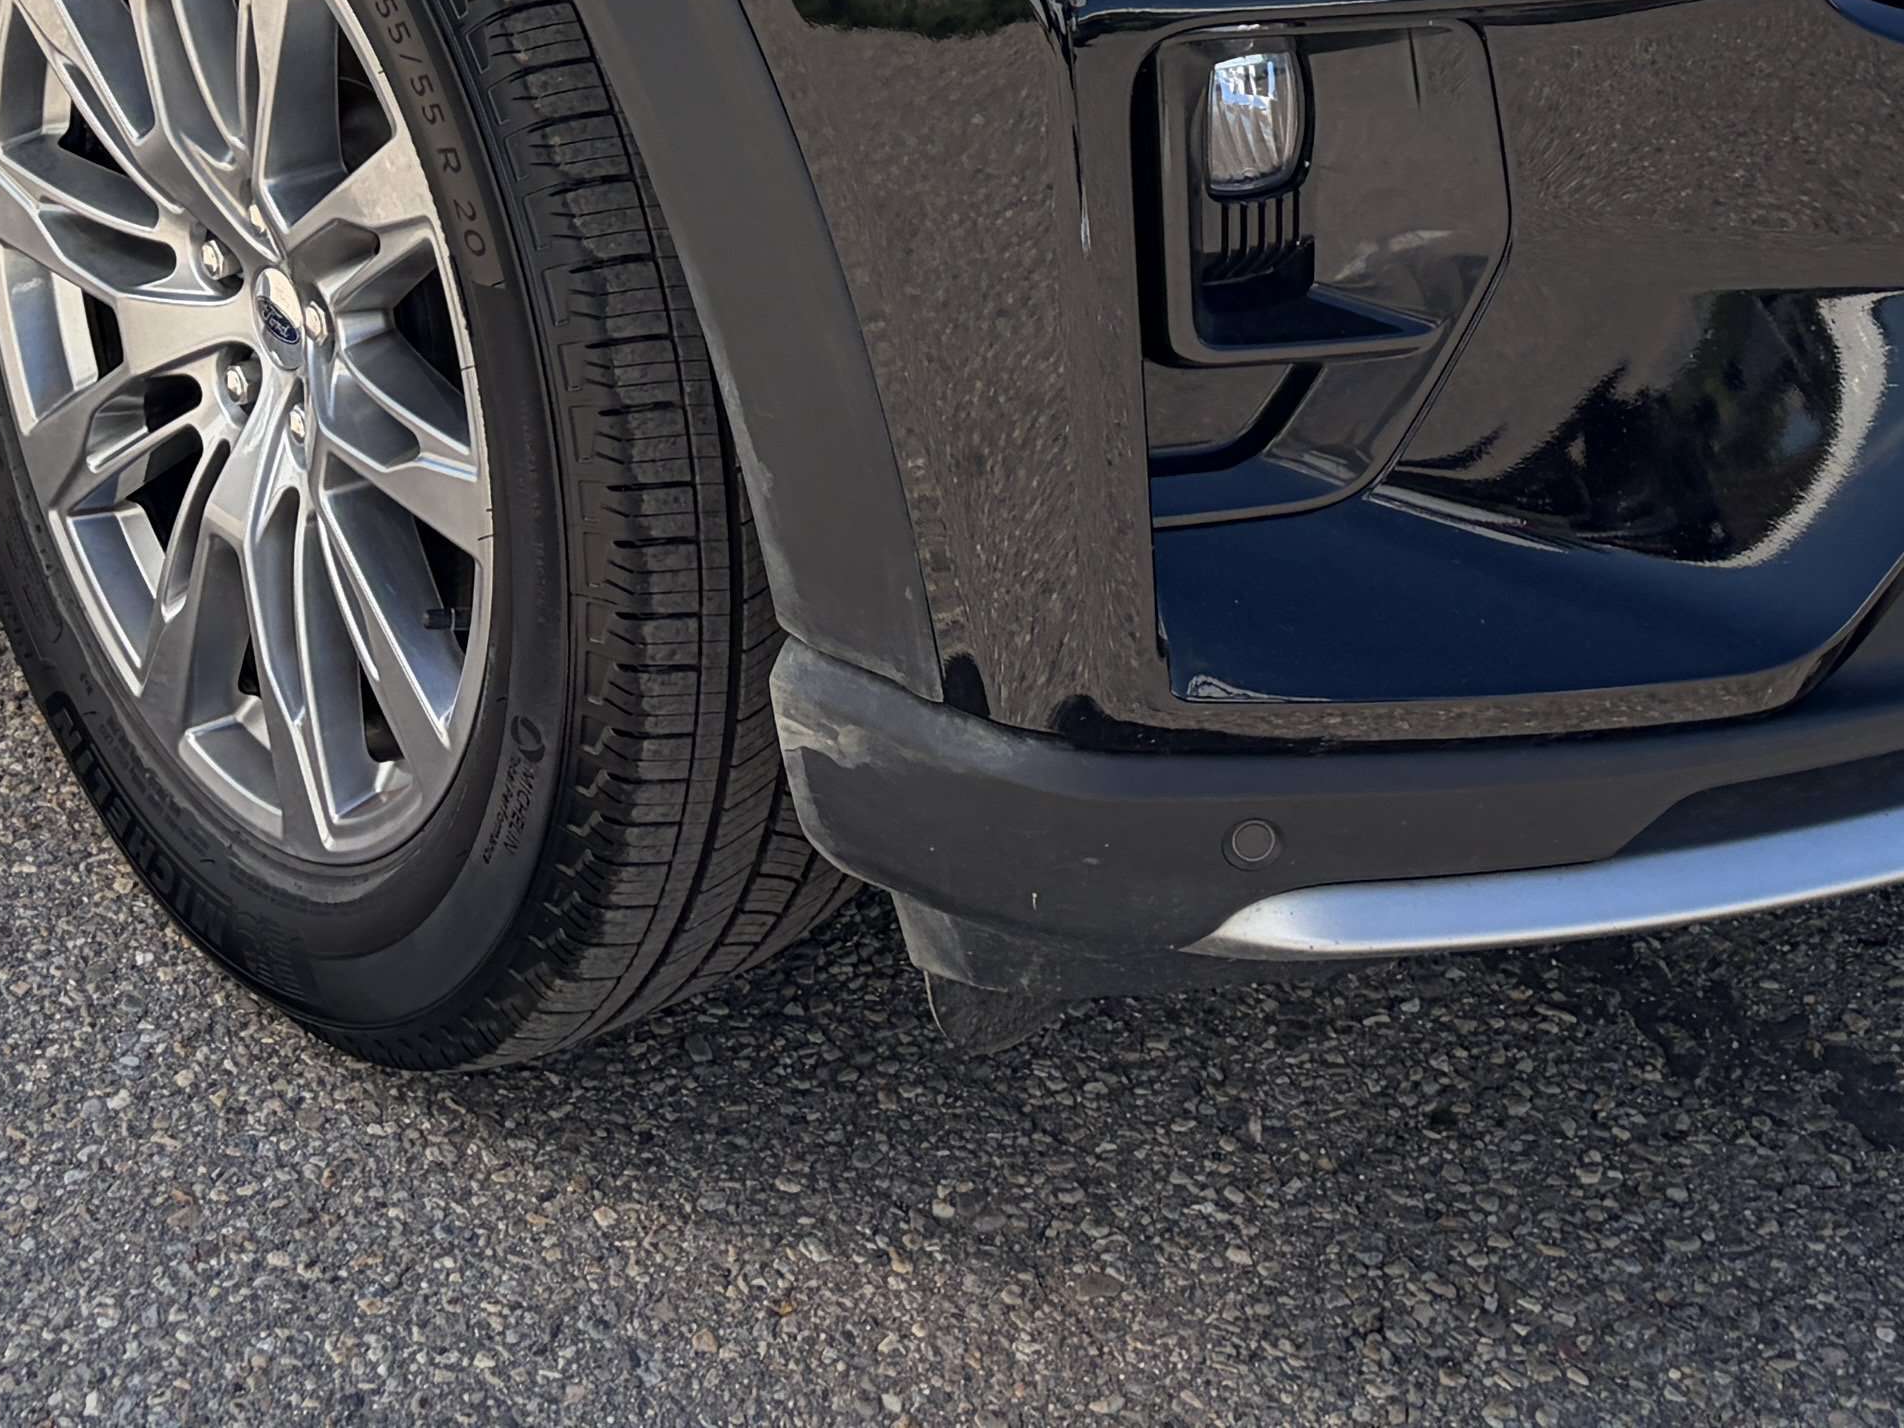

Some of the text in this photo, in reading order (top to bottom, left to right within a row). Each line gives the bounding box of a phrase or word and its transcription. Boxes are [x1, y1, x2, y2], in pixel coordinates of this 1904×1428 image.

[438, 146, 462, 175] R
[454, 199, 486, 258] 20
[52, 703, 230, 942] MICHELIN
